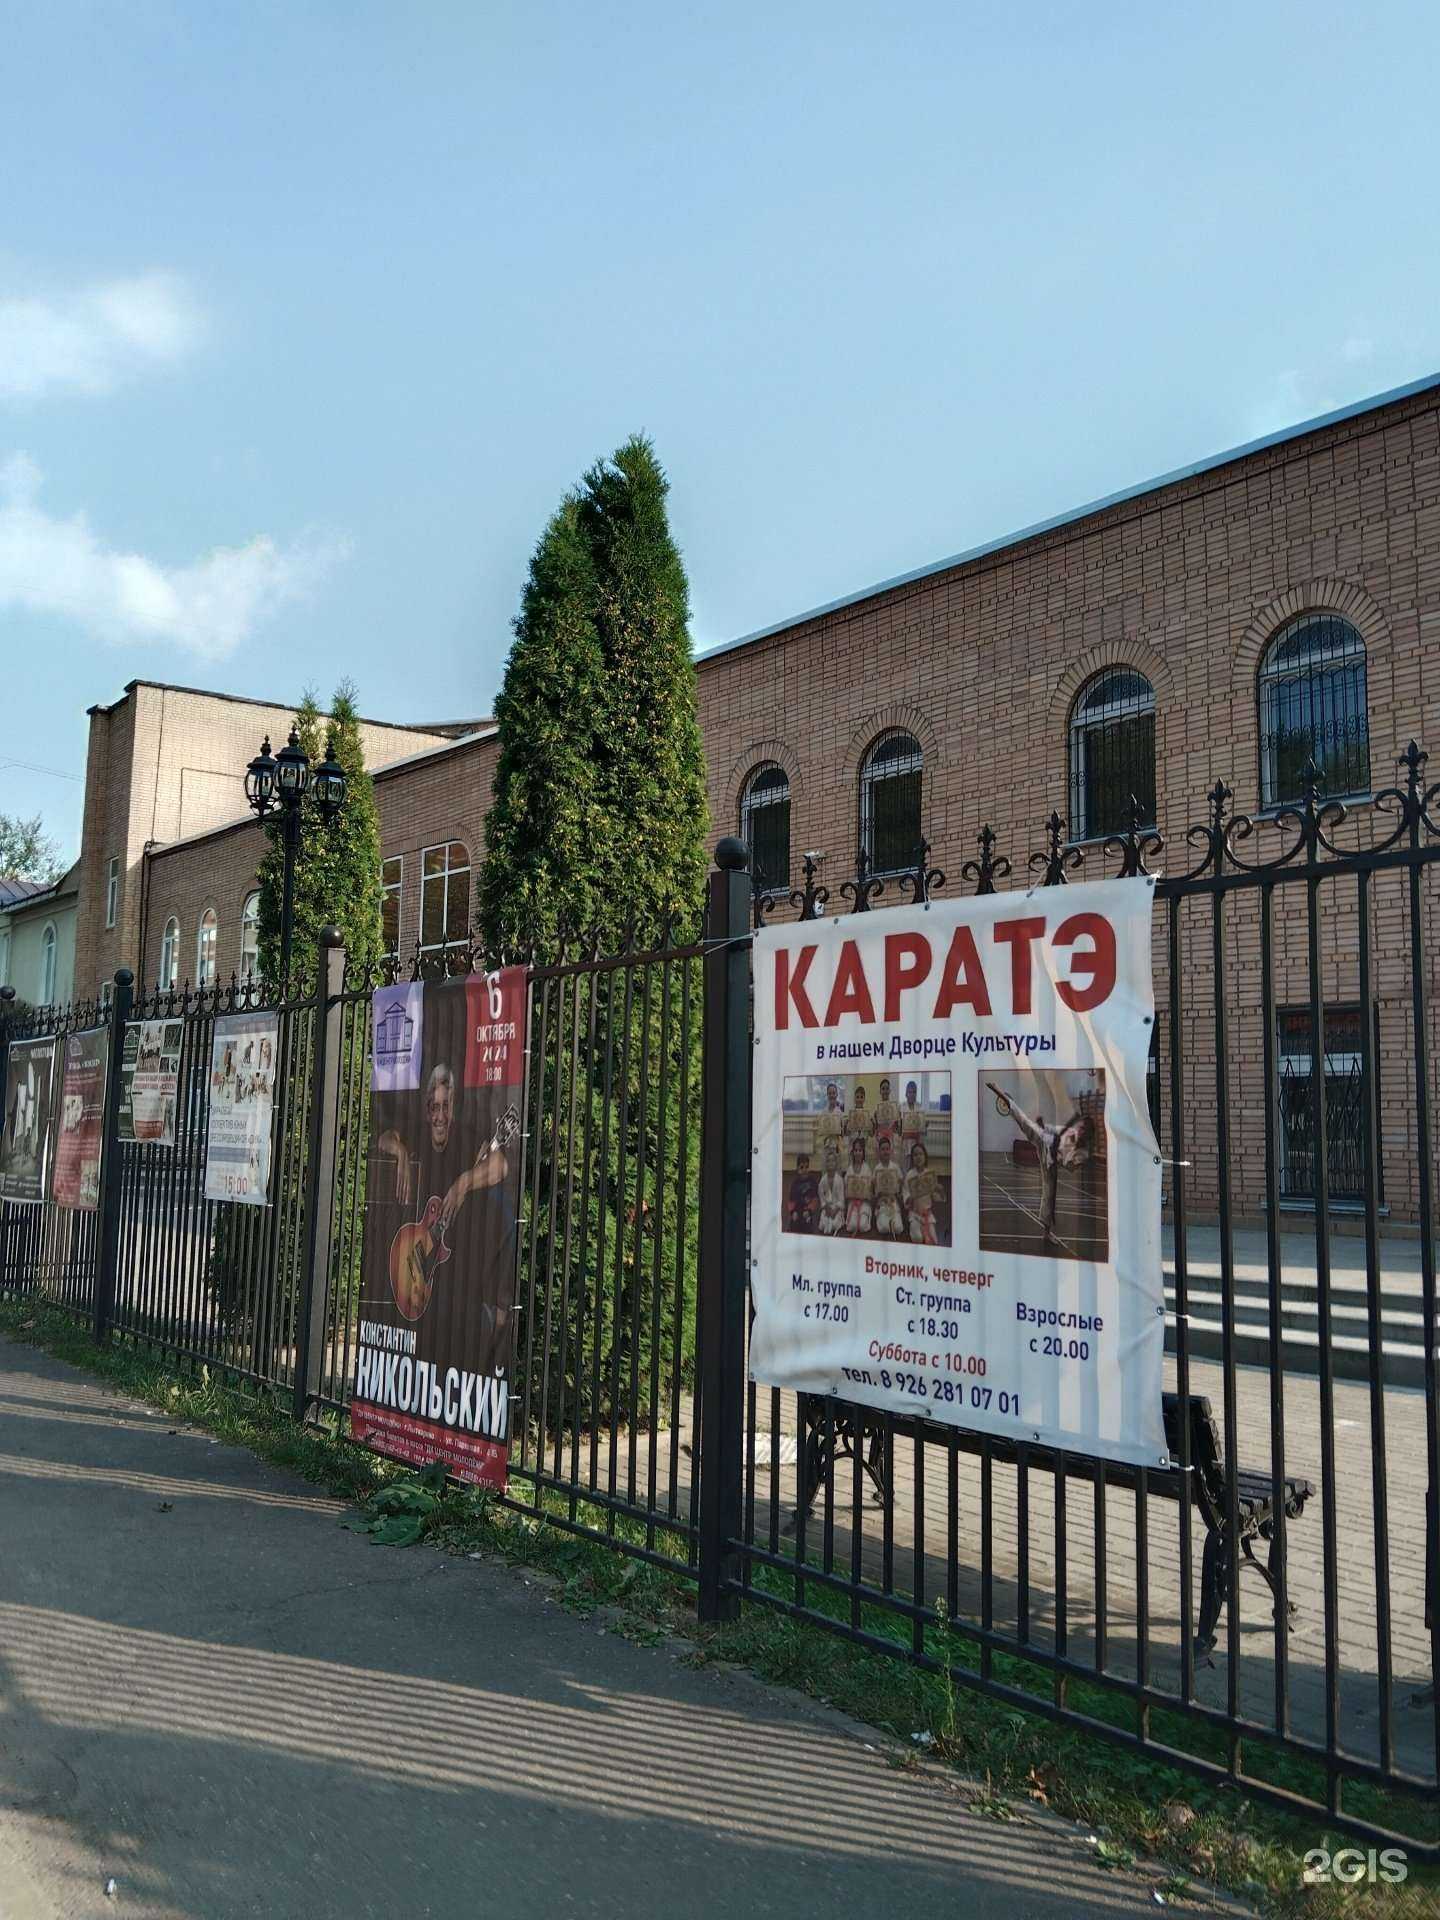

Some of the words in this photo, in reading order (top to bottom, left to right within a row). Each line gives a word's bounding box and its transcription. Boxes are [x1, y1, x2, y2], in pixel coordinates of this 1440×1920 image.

[774, 912, 1117, 1031] КАРАТЭ
[486, 971, 503, 1020] 6
[477, 1022, 516, 1042] ОКТЯБРЯ
[816, 1045, 825, 1060] в
[828, 1041, 885, 1060] нашем
[889, 1035, 956, 1060] Дворце
[961, 1031, 1056, 1055] Культуры
[485, 1067, 502, 1081] 18:00
[224, 1175, 248, 1196] 15:00
[792, 1274, 814, 1293] Мл.
[817, 1279, 862, 1299] группа
[865, 1256, 929, 1281] Вторник,
[933, 1267, 994, 1289] четверг
[804, 1304, 812, 1319] с
[815, 1302, 849, 1323] 17.00
[896, 1287, 916, 1306] Ст.
[920, 1294, 972, 1314] группа
[907, 1319, 916, 1334] с
[919, 1318, 959, 1340] 18.30
[1016, 1302, 1104, 1333] Взрослые
[360, 1320, 417, 1355] КОНСТАНТИН
[1029, 1338, 1038, 1353] с
[1042, 1336, 1090, 1361] 20.00
[868, 1340, 927, 1367] Суббота
[931, 1354, 940, 1368] с
[944, 1354, 987, 1377] 10.00
[356, 1346, 509, 1440] НИКОЛЬСКИЙ
[842, 1366, 878, 1387] тел.
[881, 1370, 892, 1389] 8
[896, 1373, 928, 1397] 926
[932, 1379, 964, 1405] 281
[971, 1389, 993, 1411] 07
[998, 1393, 1021, 1417] 01
